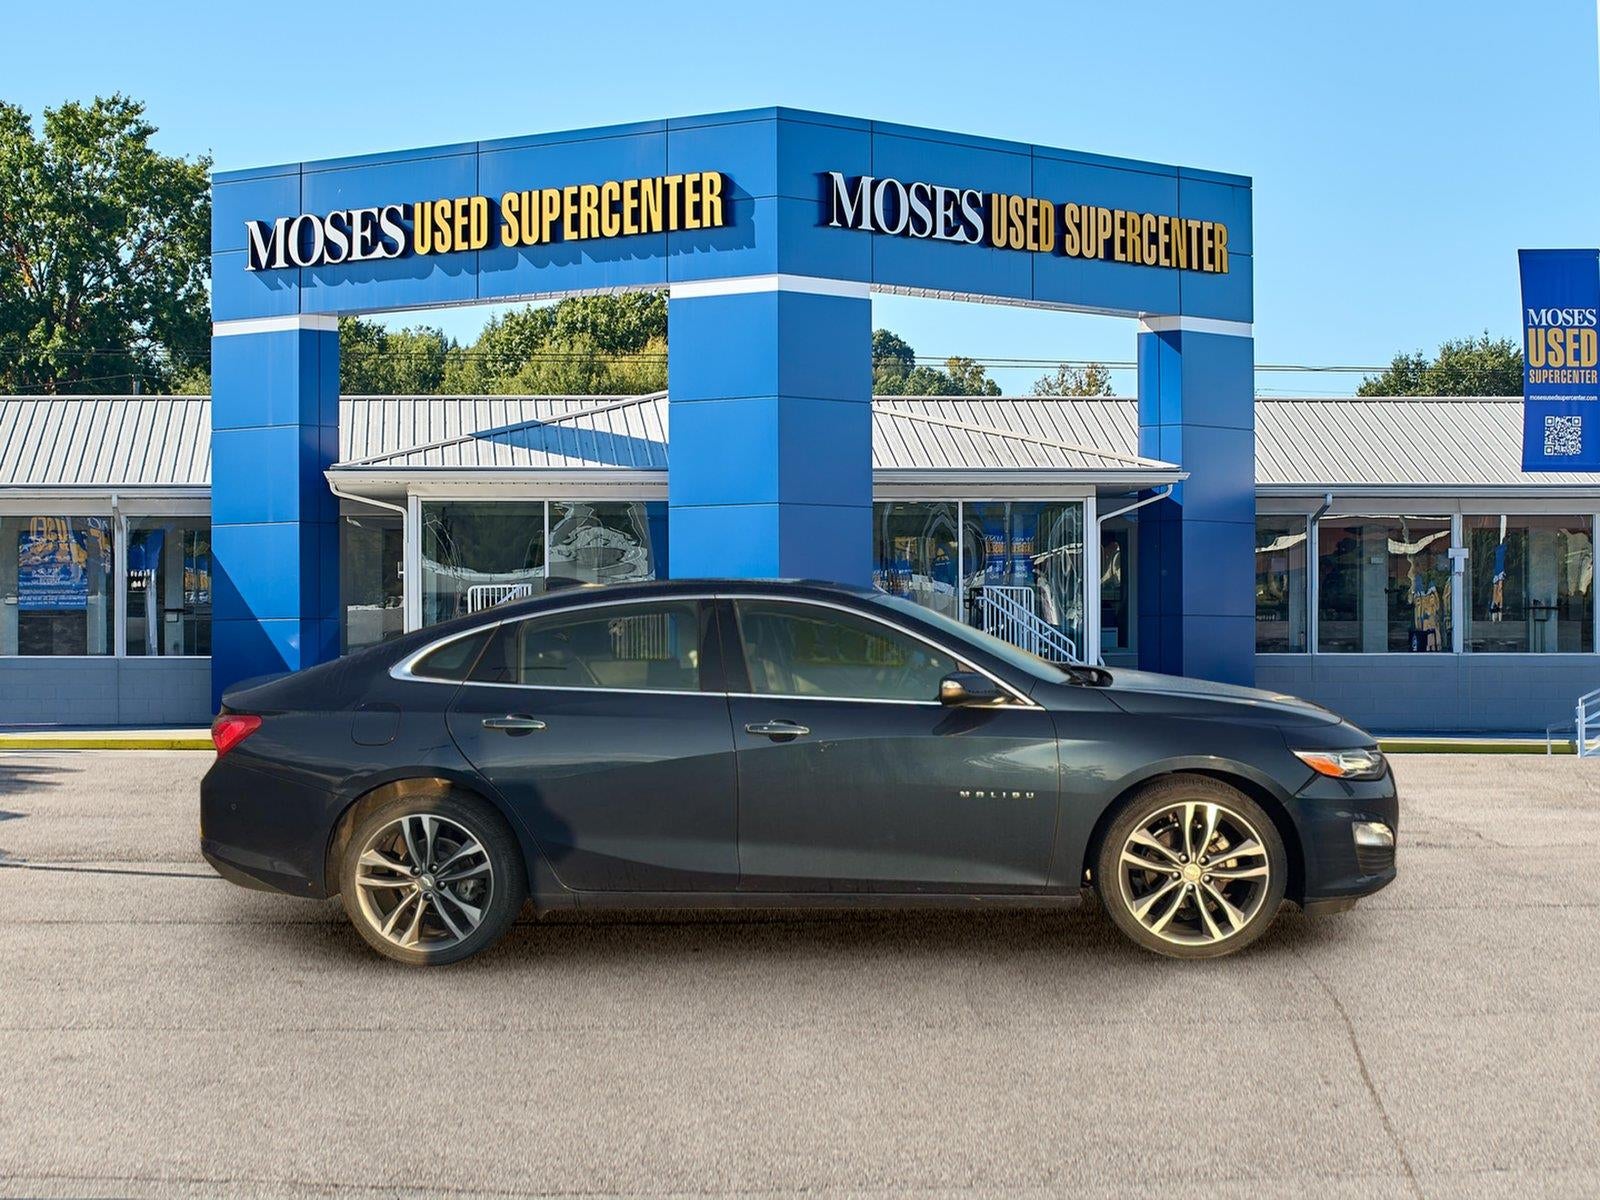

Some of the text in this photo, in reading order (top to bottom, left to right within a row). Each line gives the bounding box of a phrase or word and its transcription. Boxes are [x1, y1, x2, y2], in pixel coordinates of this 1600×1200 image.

[243, 170, 724, 271] MOSES USED SUPERCENTER
[828, 171, 1230, 274] MOSES USED SUPERCENTER
[1527, 308, 1597, 327] MOSES
[1528, 327, 1598, 368] USED
[1529, 369, 1598, 384] SUPERCENTER
[1529, 394, 1598, 402] mosesusedsupercenter.com
[959, 790, 1035, 799] MALIBU
